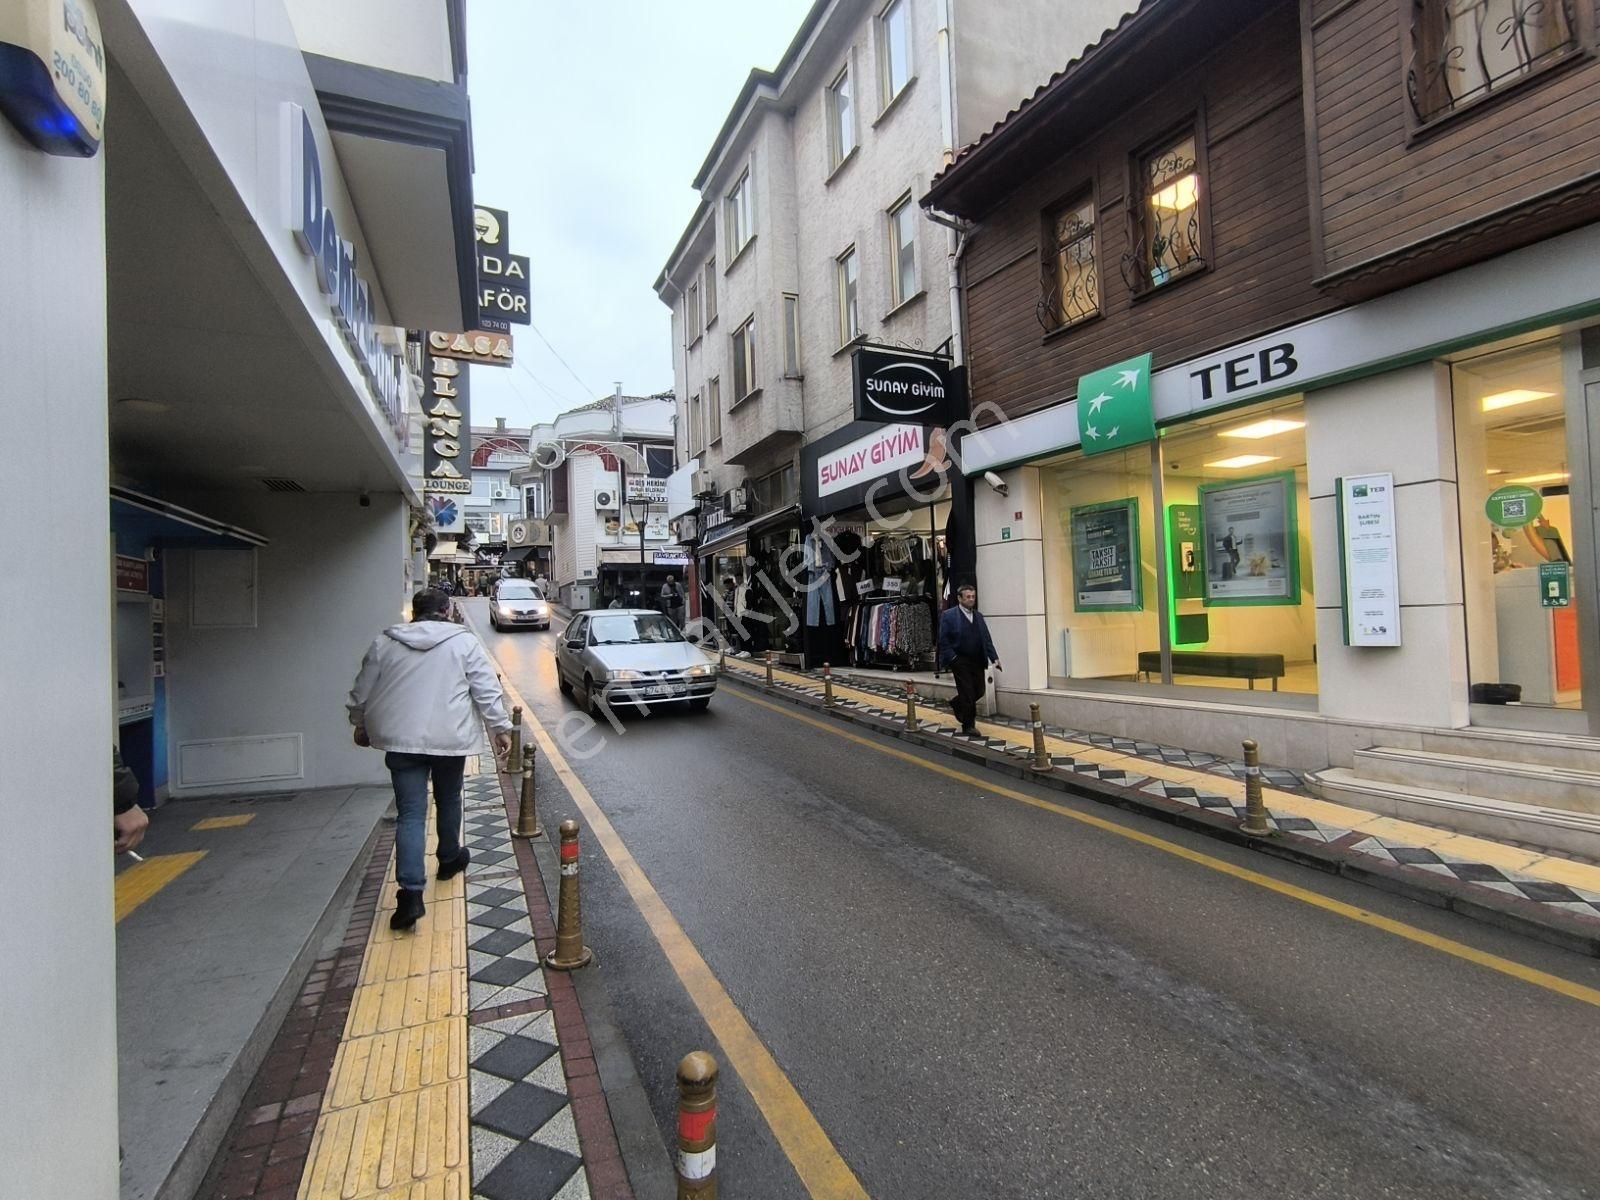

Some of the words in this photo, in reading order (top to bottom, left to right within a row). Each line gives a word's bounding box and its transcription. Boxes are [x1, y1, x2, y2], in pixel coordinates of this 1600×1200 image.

[53, 50, 75, 87] 200
[78, 82, 90, 106] 80
[476, 255, 525, 279] DA
[429, 330, 513, 358] CASA
[866, 378, 908, 394] SUNAY
[1190, 342, 1298, 400] TEB
[429, 356, 463, 478] BLANCA
[820, 448, 868, 485] SUNAY
[870, 427, 920, 465] GİYİM
[426, 480, 469, 491] LOUNGE
